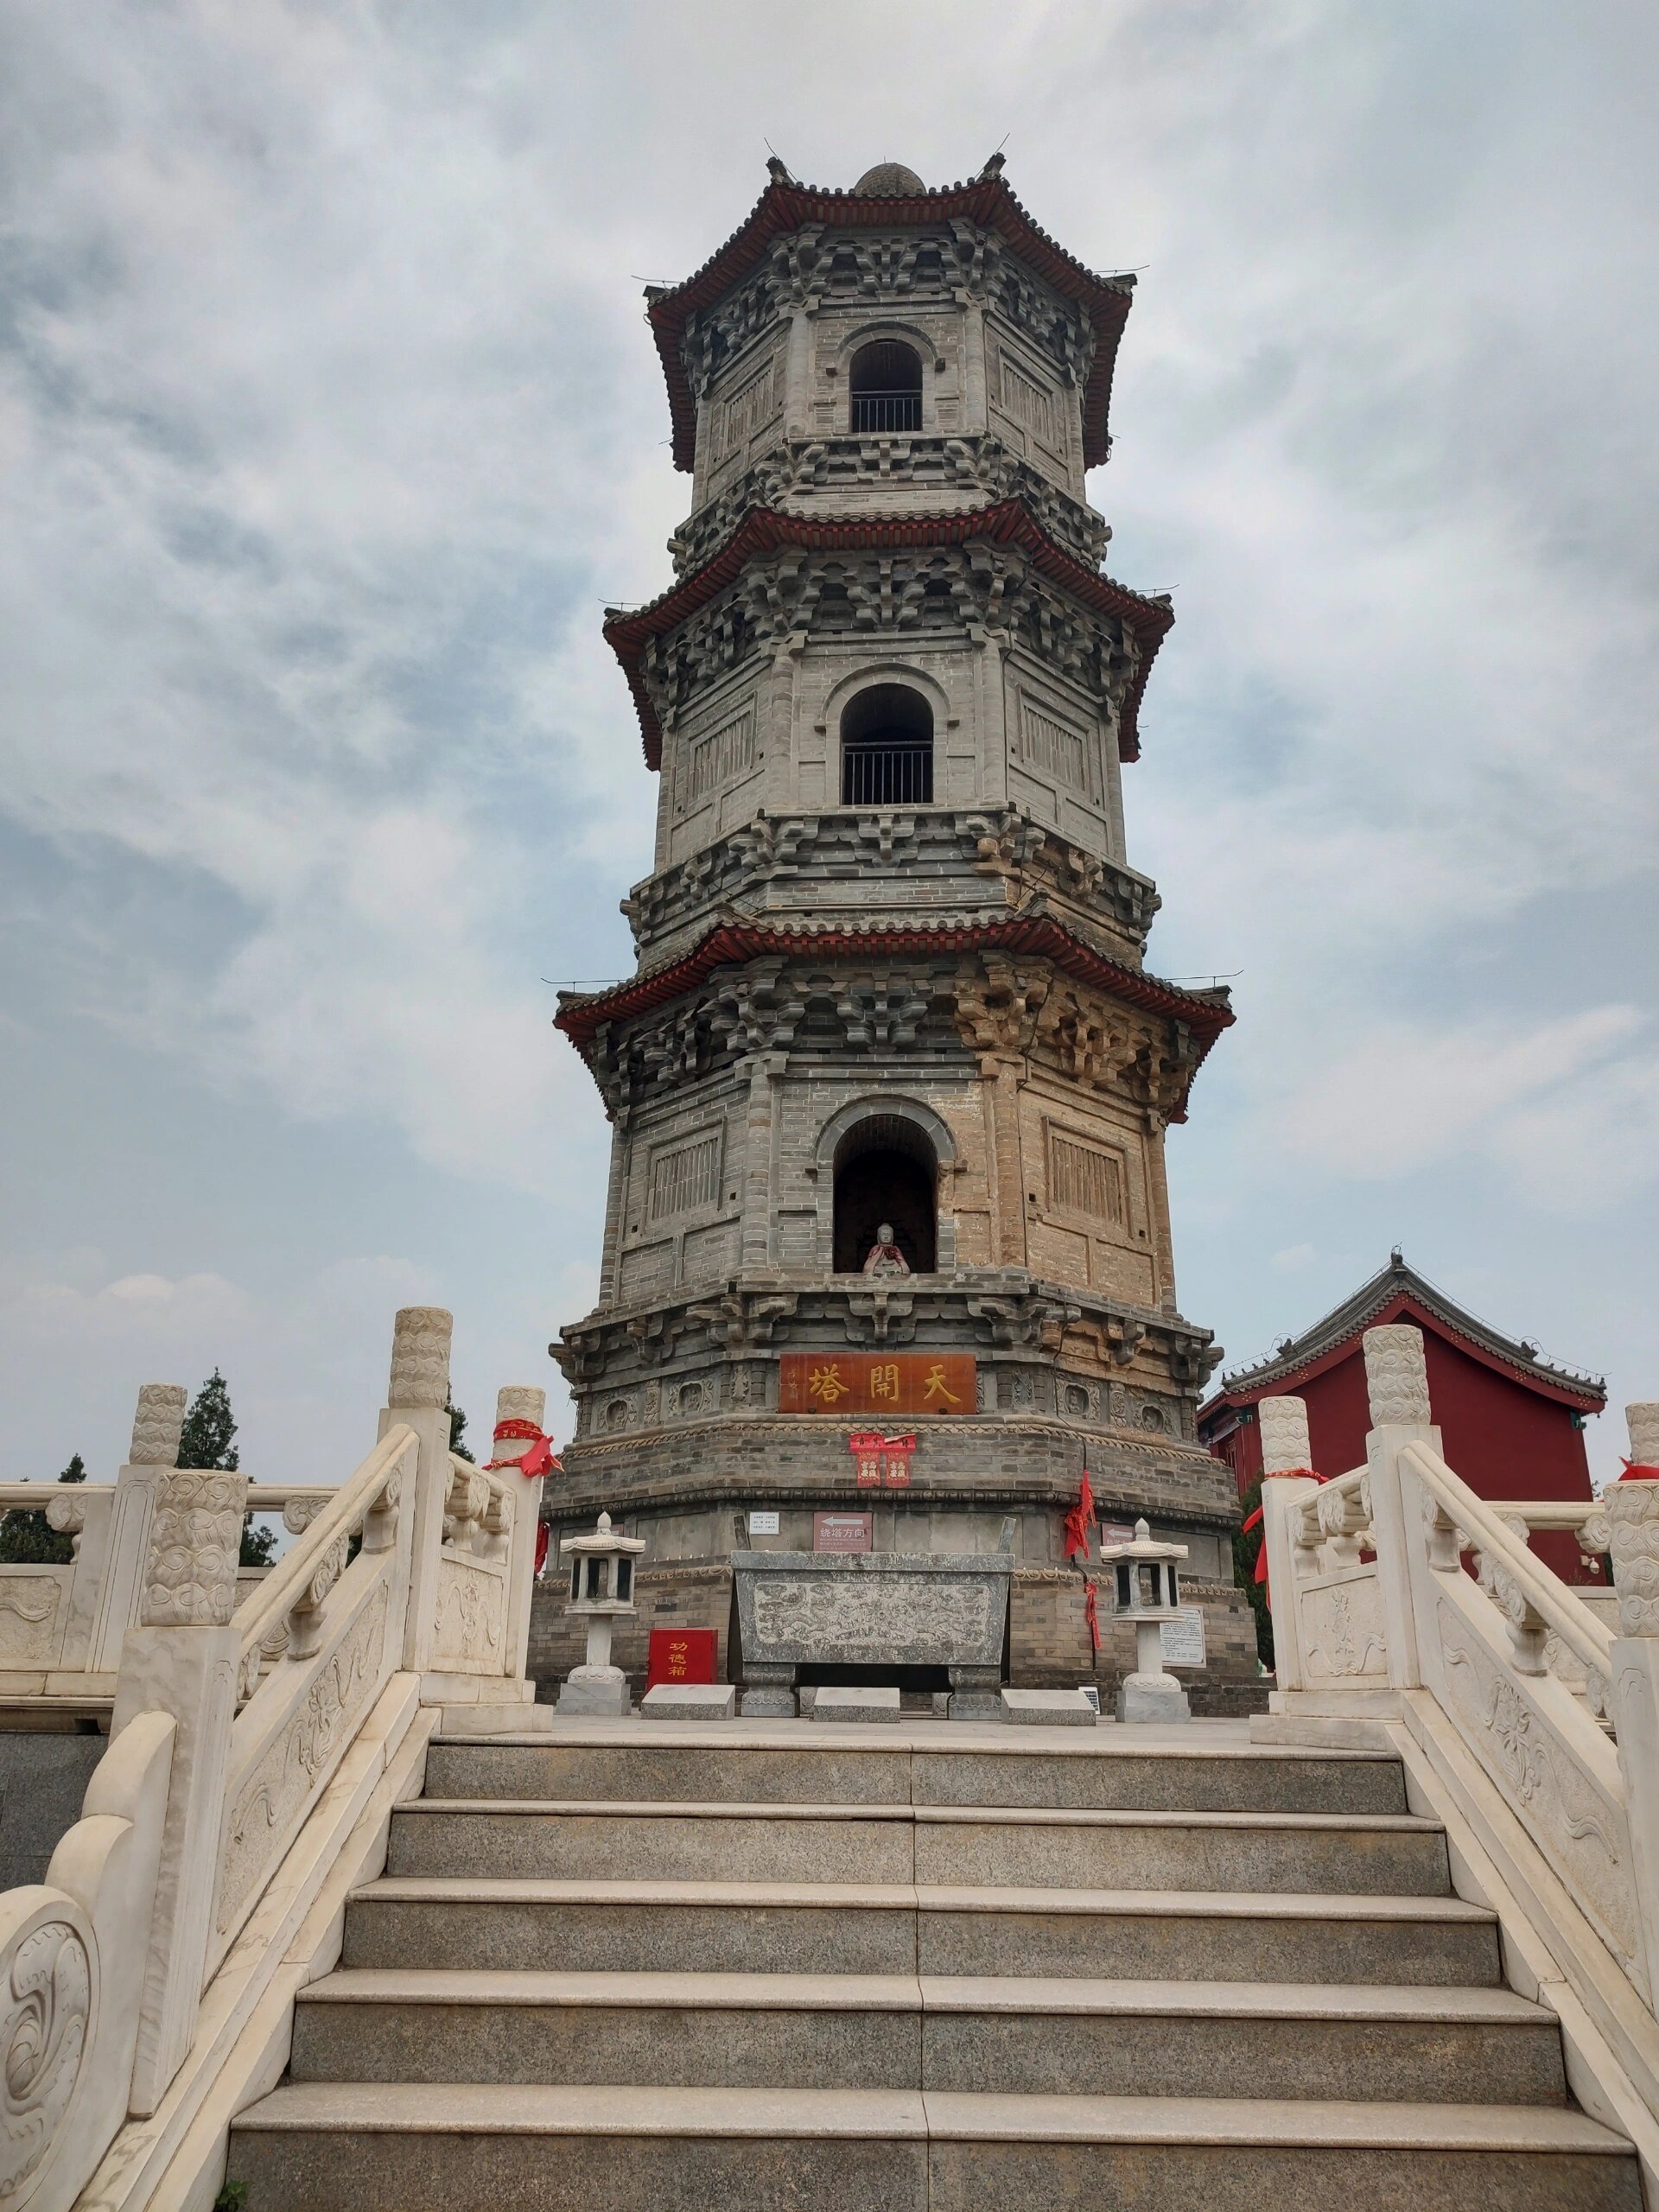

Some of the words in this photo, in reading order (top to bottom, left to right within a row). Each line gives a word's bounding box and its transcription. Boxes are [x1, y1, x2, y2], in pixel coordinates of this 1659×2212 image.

[820, 1528, 864, 1538] 绕塔方向
[668, 1642, 688, 1676] 功德箱
